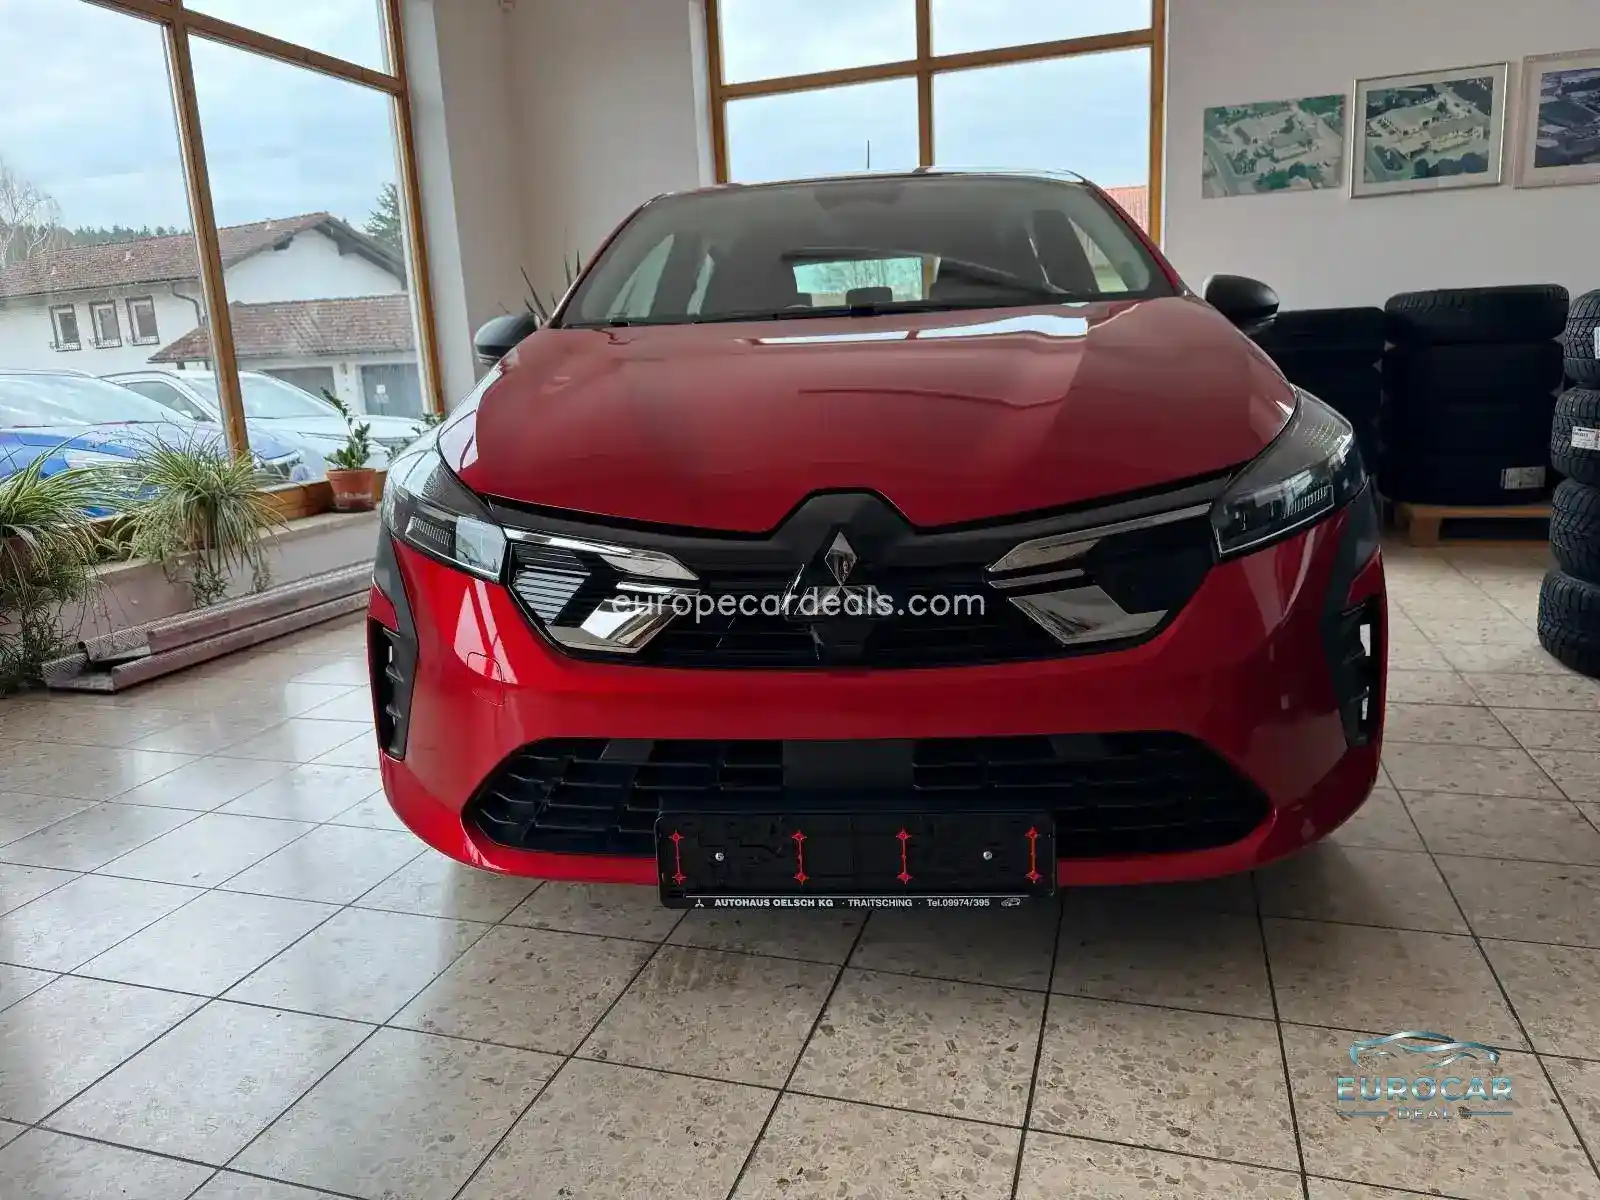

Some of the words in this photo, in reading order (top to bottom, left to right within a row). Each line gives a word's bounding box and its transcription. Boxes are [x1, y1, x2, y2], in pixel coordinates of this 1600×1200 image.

[714, 898, 770, 908] AUTOHAUS
[772, 898, 815, 908] OELSCH
[818, 898, 834, 908] KG
[847, 898, 913, 908] TRAITSCHING
